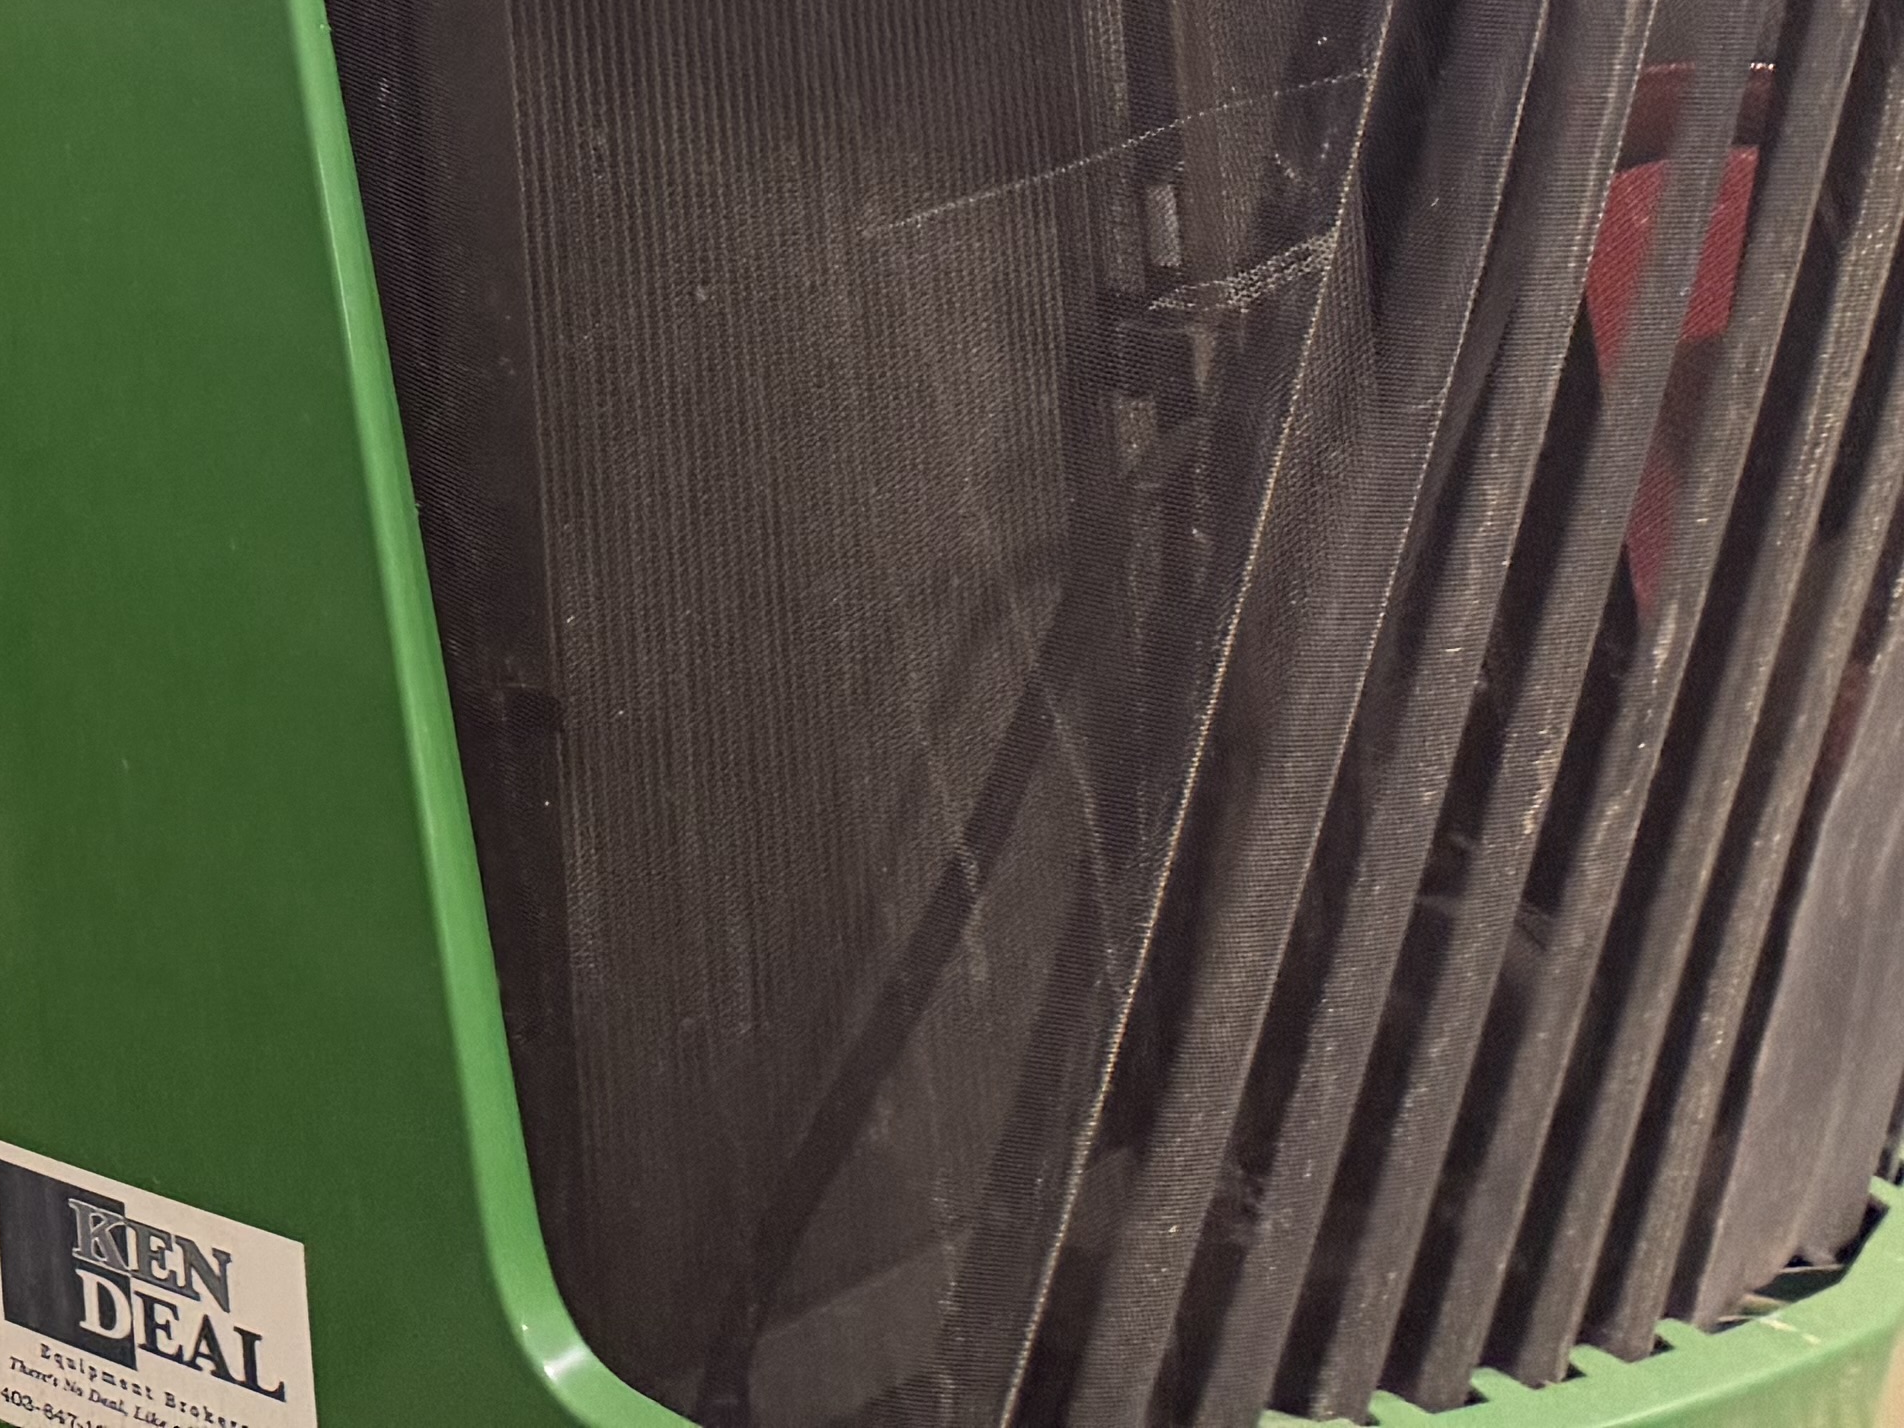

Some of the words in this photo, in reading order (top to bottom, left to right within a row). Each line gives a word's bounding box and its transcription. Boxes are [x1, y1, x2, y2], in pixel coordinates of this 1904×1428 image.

[68, 1198, 233, 1313] KEN
[40, 1343, 154, 1400] Equipment
[75, 1268, 287, 1402] DEAL
